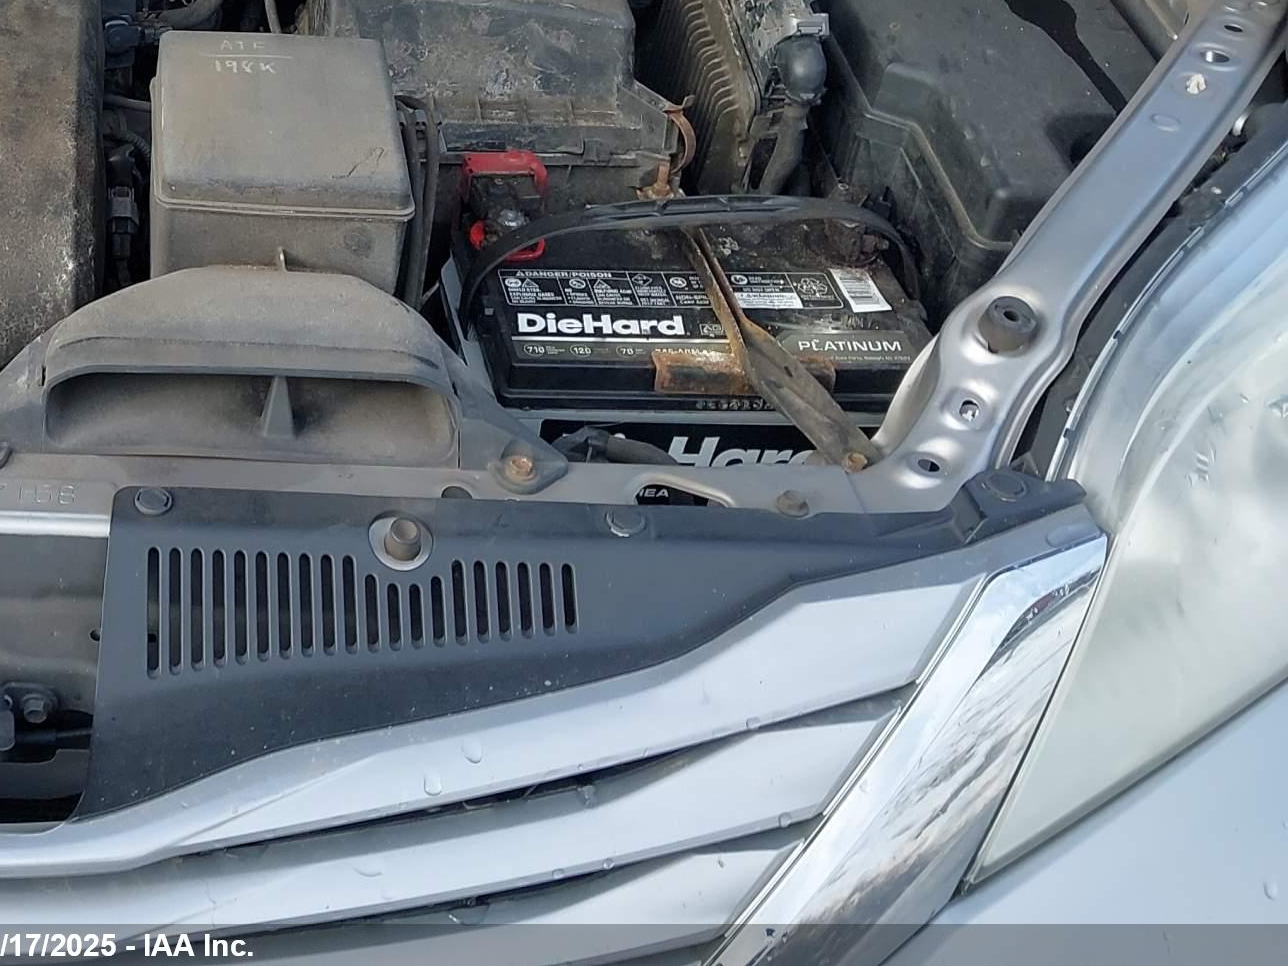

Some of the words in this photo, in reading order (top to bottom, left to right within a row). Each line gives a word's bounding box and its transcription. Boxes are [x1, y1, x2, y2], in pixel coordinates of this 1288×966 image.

[517, 313, 685, 335] DieHard
[526, 346, 545, 354] 710
[573, 347, 592, 355] 120
[798, 339, 902, 352] PLATINUM
